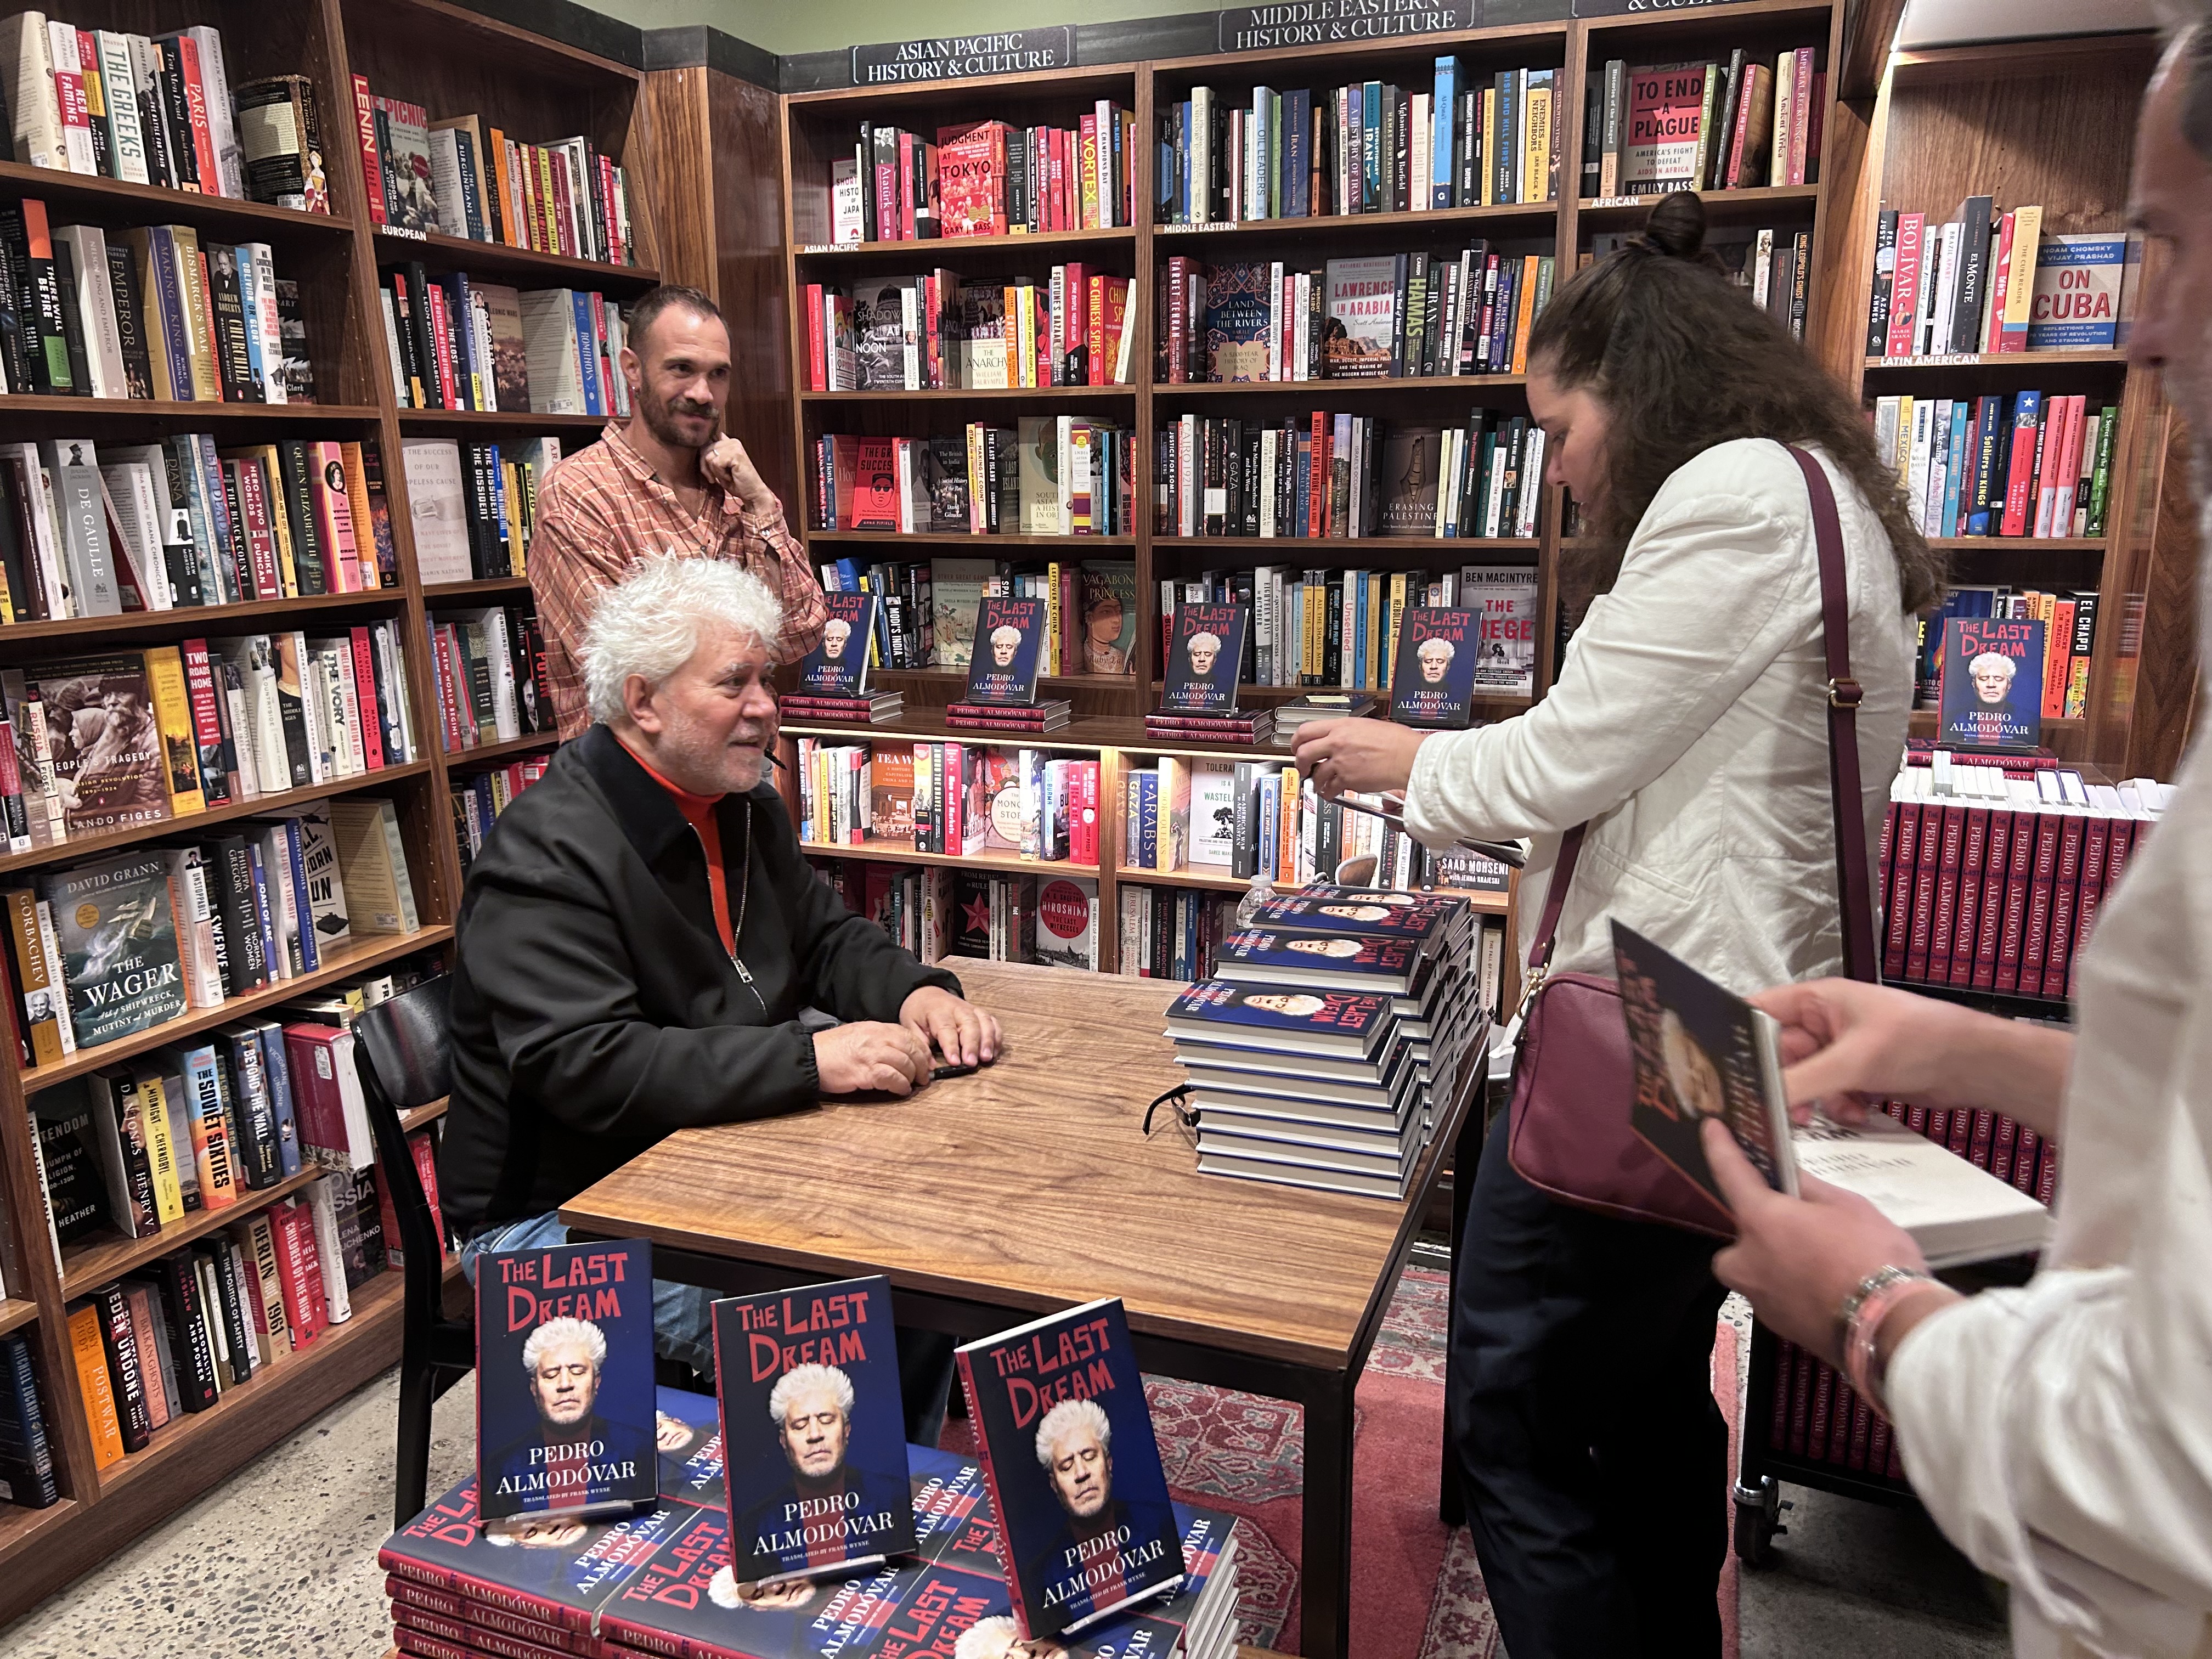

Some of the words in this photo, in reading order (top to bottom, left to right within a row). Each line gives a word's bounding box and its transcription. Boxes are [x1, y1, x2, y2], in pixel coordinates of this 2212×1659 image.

[1250, 3, 1334, 27] MIDDLE
[1339, 0, 1438, 14] EASTERN
[1235, 25, 1323, 49] HISTORY
[1329, 22, 1348, 39] &
[1350, 10, 1456, 38] CULTURE
[895, 41, 950, 61] ASIAN
[953, 34, 1023, 55] PACIFIC
[105, 51, 130, 86] THE
[868, 61, 944, 82] HISTORY
[947, 60, 964, 76] &
[965, 49, 1054, 75] CULTURE
[1503, 72, 1511, 96] RISE
[1637, 81, 1658, 100] TO
[1665, 78, 1701, 96] END
[61, 75, 78, 123] FAMINE
[75, 88, 88, 114] RED
[189, 83, 207, 128] PARIS
[1662, 104, 1669, 115] A
[111, 88, 141, 159] GREEKS
[354, 78, 376, 153] LENIN
[386, 99, 427, 129] PICNIC
[1634, 117, 1699, 138] PLAGUE
[941, 132, 990, 148] JUDGMENT
[1635, 148, 1669, 157] AMERICA'S
[1674, 146, 1693, 155] FIGHT
[1501, 143, 1509, 167] FIRST
[1658, 156, 1681, 165] DEFEAT
[459, 145, 473, 215] BURGUNDIANS
[941, 160, 991, 179] TOKYO
[1082, 136, 1096, 202] VORTEX
[1257, 148, 1266, 196] LEADERS
[880, 166, 893, 208] Atatürk
[1632, 183, 1663, 194] EMILY
[1667, 180, 1694, 193] BASS
[1592, 196, 1639, 208] AFRICAN
[381, 224, 427, 241] EUROPEAN
[1164, 223, 1196, 233] MIDDLE
[1198, 222, 1238, 232] EASTERN
[830, 242, 859, 251] PACIFIC
[1897, 219, 1918, 299] BOLÍVAR
[1971, 253, 1977, 265] EL
[2070, 245, 2112, 253] CHOMSKY
[1171, 261, 1181, 299] TARGET
[1335, 280, 1393, 297] LAWRENCE
[1963, 265, 1976, 304] MONTE
[2059, 270, 2090, 289] ON
[111, 260, 134, 346] EMPEROR
[1092, 289, 1101, 326] CHINESE
[1221, 309, 1262, 319] BETWEEN
[1228, 300, 1254, 308] LAND
[1337, 302, 1346, 316] IN
[1349, 299, 1390, 315] ARABIA
[1408, 278, 1424, 336] HAMAS
[1427, 291, 1437, 323] IRAN
[2033, 292, 2111, 320] CUBA
[887, 325, 900, 336] AT
[1171, 302, 1181, 341] TEHRAN
[1234, 318, 1268, 327] RIVERS
[229, 319, 250, 384] CHURCHILL
[856, 342, 887, 354] NOON
[1091, 328, 1101, 354] SPIES
[1880, 357, 1912, 366] LATIN
[1915, 354, 1979, 365] AMERICAN
[286, 383, 304, 392] Clark
[471, 447, 481, 465] THE
[1900, 426, 1909, 463] MEXICO
[1982, 435, 1993, 469] Soldiers
[1229, 461, 1237, 491] GAZA
[78, 488, 91, 508] DE
[244, 476, 256, 516] WORLDS
[249, 466, 259, 492] HERO
[255, 503, 264, 525] TWO
[475, 468, 489, 521] DISSIDENT
[1977, 479, 1988, 506] KINGS
[83, 514, 104, 577] GAULLE
[253, 543, 266, 584] DUNCAN
[263, 550, 273, 574] MIKE
[1465, 573, 1484, 583] BEN
[1487, 573, 1538, 584] MACINTYRE
[987, 600, 1000, 612] THE
[1002, 600, 1035, 614] LAST
[1183, 606, 1198, 619] THE
[1200, 607, 1236, 621] LAST
[1486, 600, 1515, 612] THE
[2080, 600, 2093, 613] EL
[889, 607, 902, 634] MODI'S
[986, 614, 1030, 629] DREAM
[1182, 619, 1231, 636] DREAM
[1957, 621, 1980, 634] THE
[1982, 621, 2032, 640] LAST
[2075, 616, 2091, 651] CHAPO
[187, 653, 207, 664] TWO
[892, 636, 902, 656] INDIA
[1961, 634, 2025, 658] DREAM
[189, 665, 211, 677] ROADS
[190, 677, 213, 690] HOME
[535, 651, 549, 698] PUTIN
[986, 673, 1014, 681] PEDRO
[973, 681, 1024, 692] ALMODÓVAR
[1169, 690, 1226, 702] ALMODÓVAR
[1183, 682, 1215, 691] PEDRO
[1949, 721, 2029, 735] ALMODÓVAR
[1969, 712, 2011, 722] PEDRO
[105, 752, 151, 766] TRAGEDY
[1130, 782, 1139, 820] GAZA
[120, 809, 163, 823] FIGES
[1143, 789, 1157, 850] ARABS
[1900, 820, 1914, 861] PEDRO
[67, 875, 110, 894] DAVID
[114, 862, 159, 882] GRANN
[1442, 858, 1465, 872] SAAD
[1468, 859, 1509, 875] MOHSENI
[191, 872, 208, 917] UNSTOPPABLE
[1042, 901, 1088, 918] HIROSHIMA
[1891, 872, 1909, 945] ALMODÓVAR
[19, 895, 45, 983] GORBACHEV
[211, 915, 229, 969] SWERVE
[244, 934, 256, 970] WOMEN
[250, 931, 262, 969] NORMAL
[114, 956, 143, 973] THE
[83, 963, 178, 1007] WAGER
[120, 991, 174, 1013] SHIPWRECK,
[92, 1017, 132, 1036] MUTINY
[144, 1000, 182, 1019] MURDER
[196, 1068, 213, 1079] THE
[243, 1048, 260, 1094] BEYOND
[199, 1079, 221, 1128] SOVIET
[250, 1091, 264, 1113] THE
[253, 1112, 270, 1141] WALL
[206, 1131, 230, 1189] SIXTIES
[136, 1171, 153, 1215] HENRY
[145, 1216, 155, 1226] V
[58, 1205, 95, 1228] HEATHER
[253, 1223, 275, 1282] BERLIN
[268, 1301, 285, 1336] 1961
[498, 1260, 537, 1284] THE
[543, 1252, 628, 1289] LAST
[508, 1286, 622, 1333] DREAM
[736, 1304, 778, 1331] THE
[782, 1291, 869, 1336] LAST
[109, 1292, 125, 1334] EDEN
[117, 1336, 139, 1402] UNDONE
[748, 1330, 867, 1383] DREAM
[990, 1344, 1032, 1377] THE
[1032, 1317, 1111, 1375] LAST
[92, 1365, 116, 1440] POSTWAR
[1006, 1358, 1116, 1430] DREAM
[529, 1441, 605, 1465] PEDRO
[495, 1461, 637, 1495] ALMODÓVAR
[523, 1492, 560, 1503] TRANSLATED
[571, 1489, 589, 1497] FRANK
[591, 1487, 611, 1495] WYNNE
[783, 1491, 860, 1522] PEDRO
[752, 1511, 895, 1555] ALMODÓVAR
[1064, 1525, 1131, 1568] PEDRO
[1043, 1539, 1165, 1609] ALMODÓVAR
